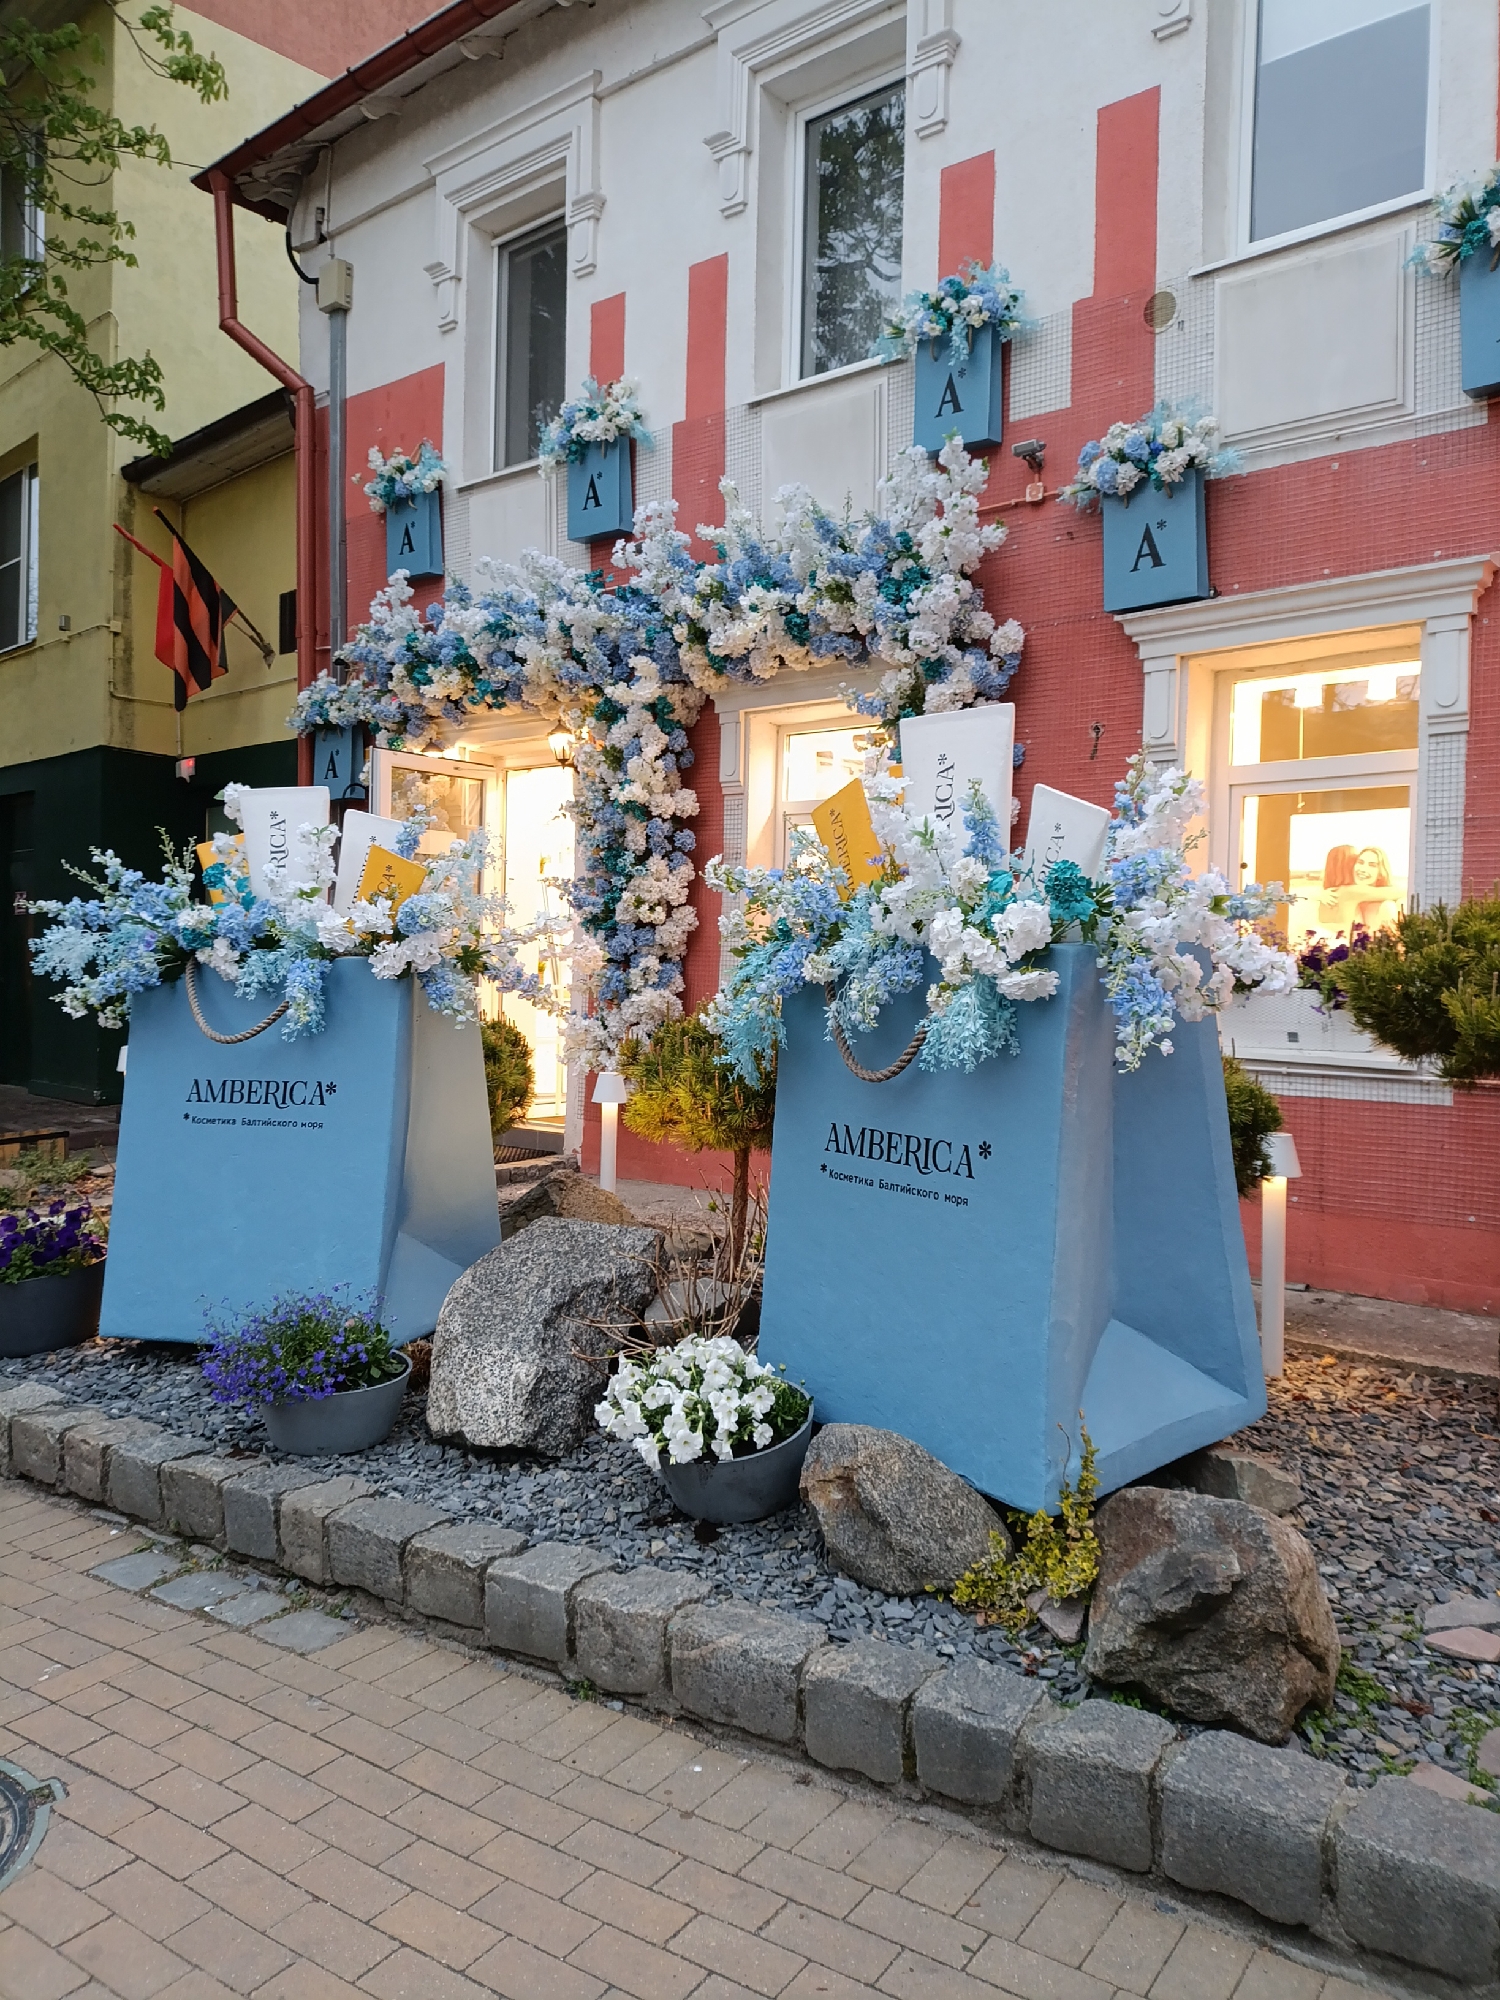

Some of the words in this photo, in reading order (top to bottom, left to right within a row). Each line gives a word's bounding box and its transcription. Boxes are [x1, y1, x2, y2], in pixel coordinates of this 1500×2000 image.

[241, 1117, 298, 1128] Балтийского
[300, 1121, 324, 1130] моря
[878, 1178, 940, 1201] Балтийского
[944, 1193, 969, 1207] моря
